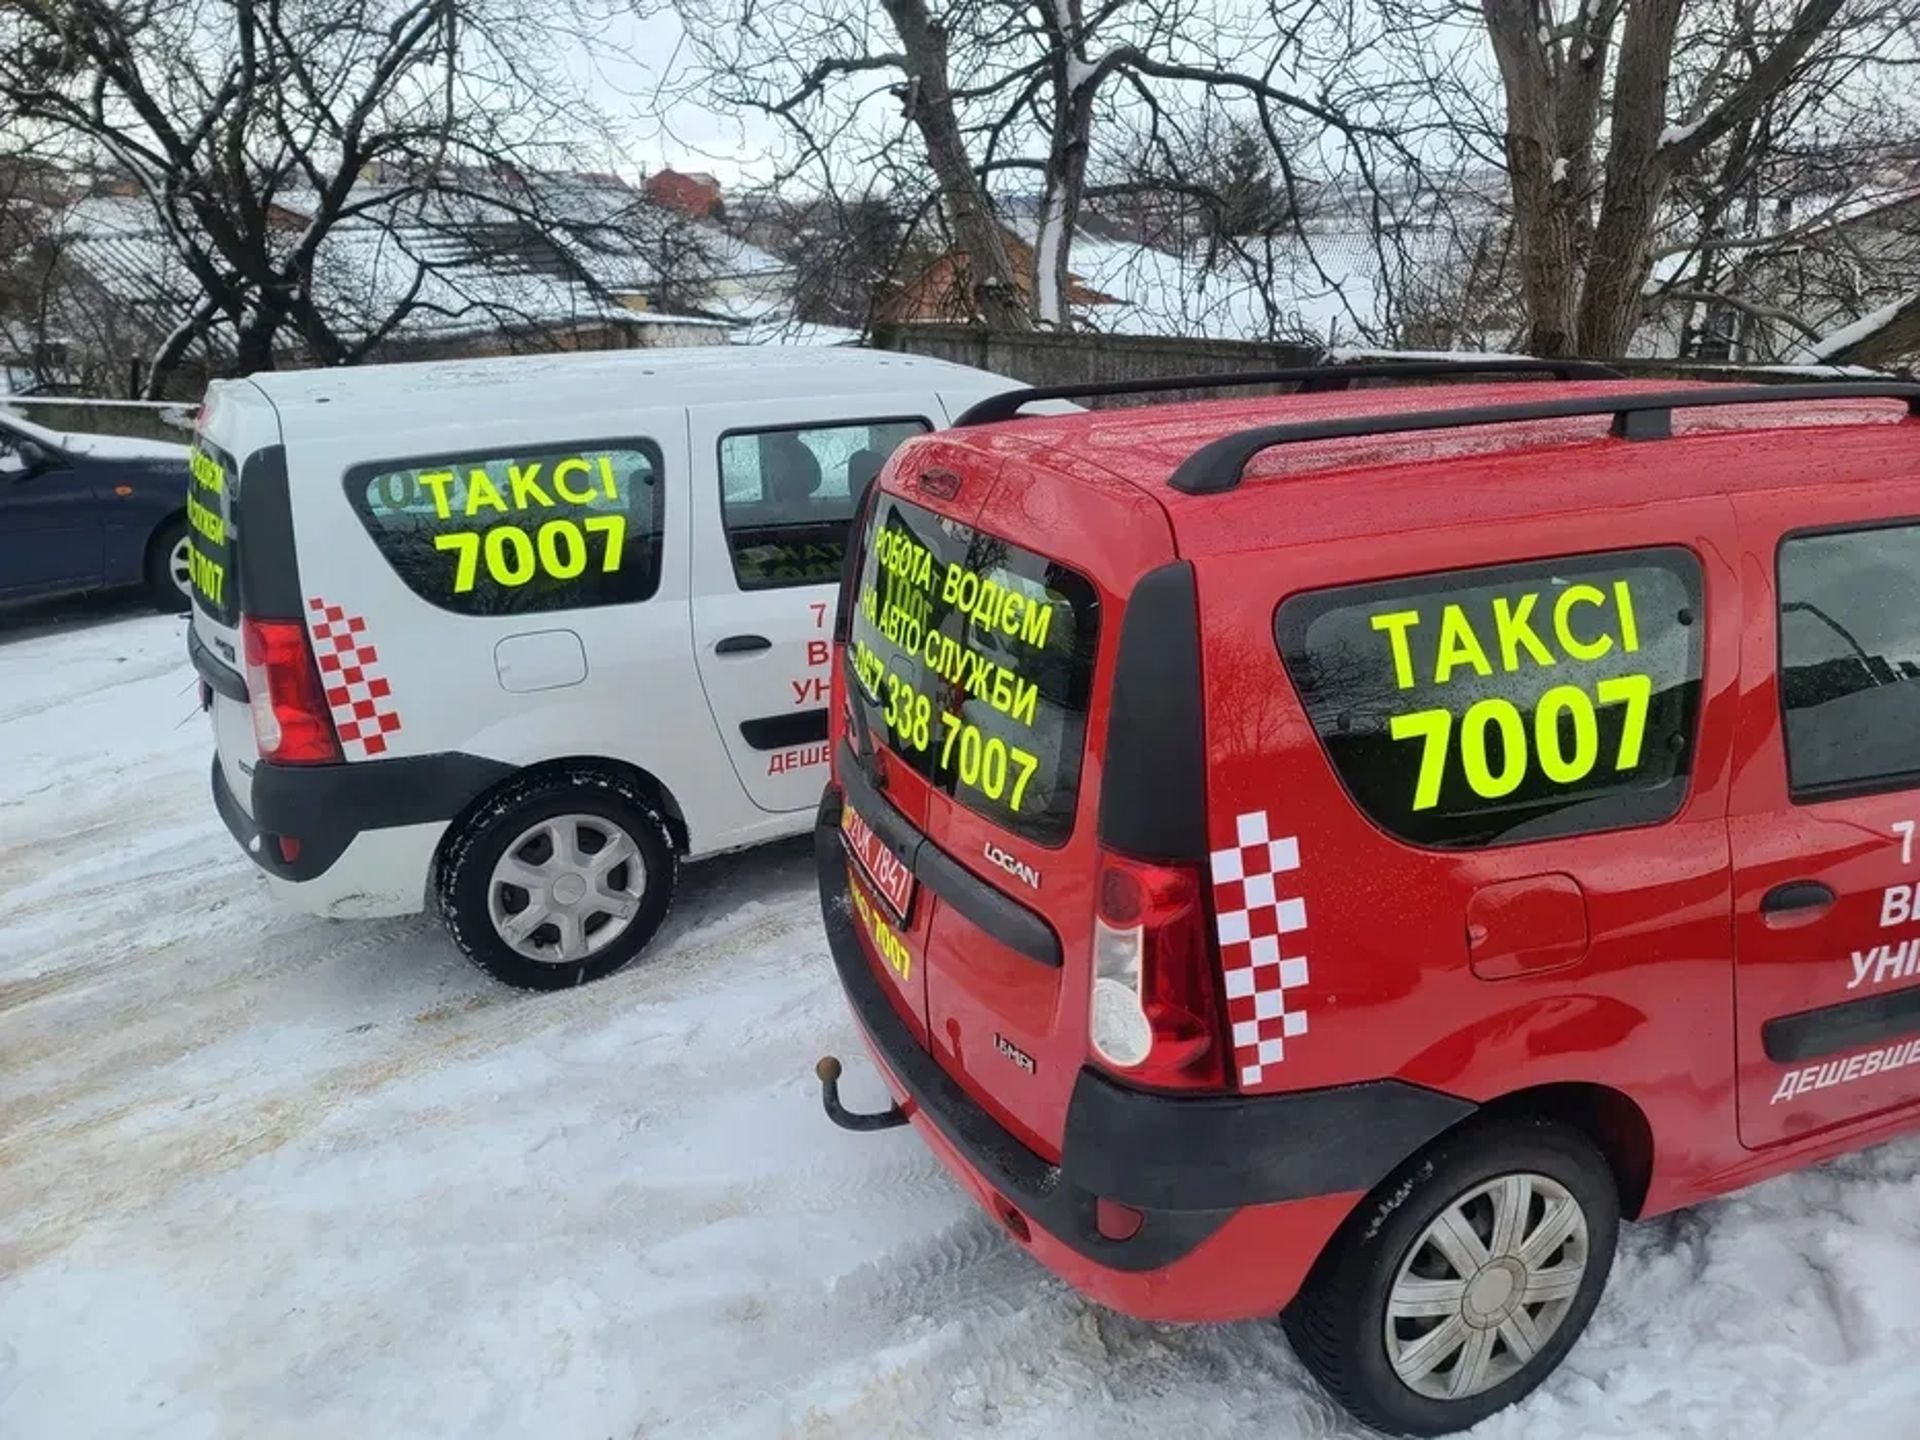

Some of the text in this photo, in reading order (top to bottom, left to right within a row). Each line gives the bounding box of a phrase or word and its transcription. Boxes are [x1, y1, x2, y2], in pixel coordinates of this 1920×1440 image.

[418, 457, 619, 519] ТАКСІ
[433, 515, 627, 593] 7007
[874, 526, 931, 591] РОБОТА
[942, 563, 1052, 649] ВОДІЄМ
[862, 583, 878, 627] НА
[878, 600, 921, 656] АВТО
[924, 629, 1039, 726] СЛУЖБИ
[1369, 581, 1640, 690] ТАКСІ
[884, 673, 931, 752] 338
[941, 711, 1038, 812] 7007
[1389, 674, 1652, 812] 7007
[984, 842, 1040, 889] LOGAN
[872, 909, 910, 982] 7007
